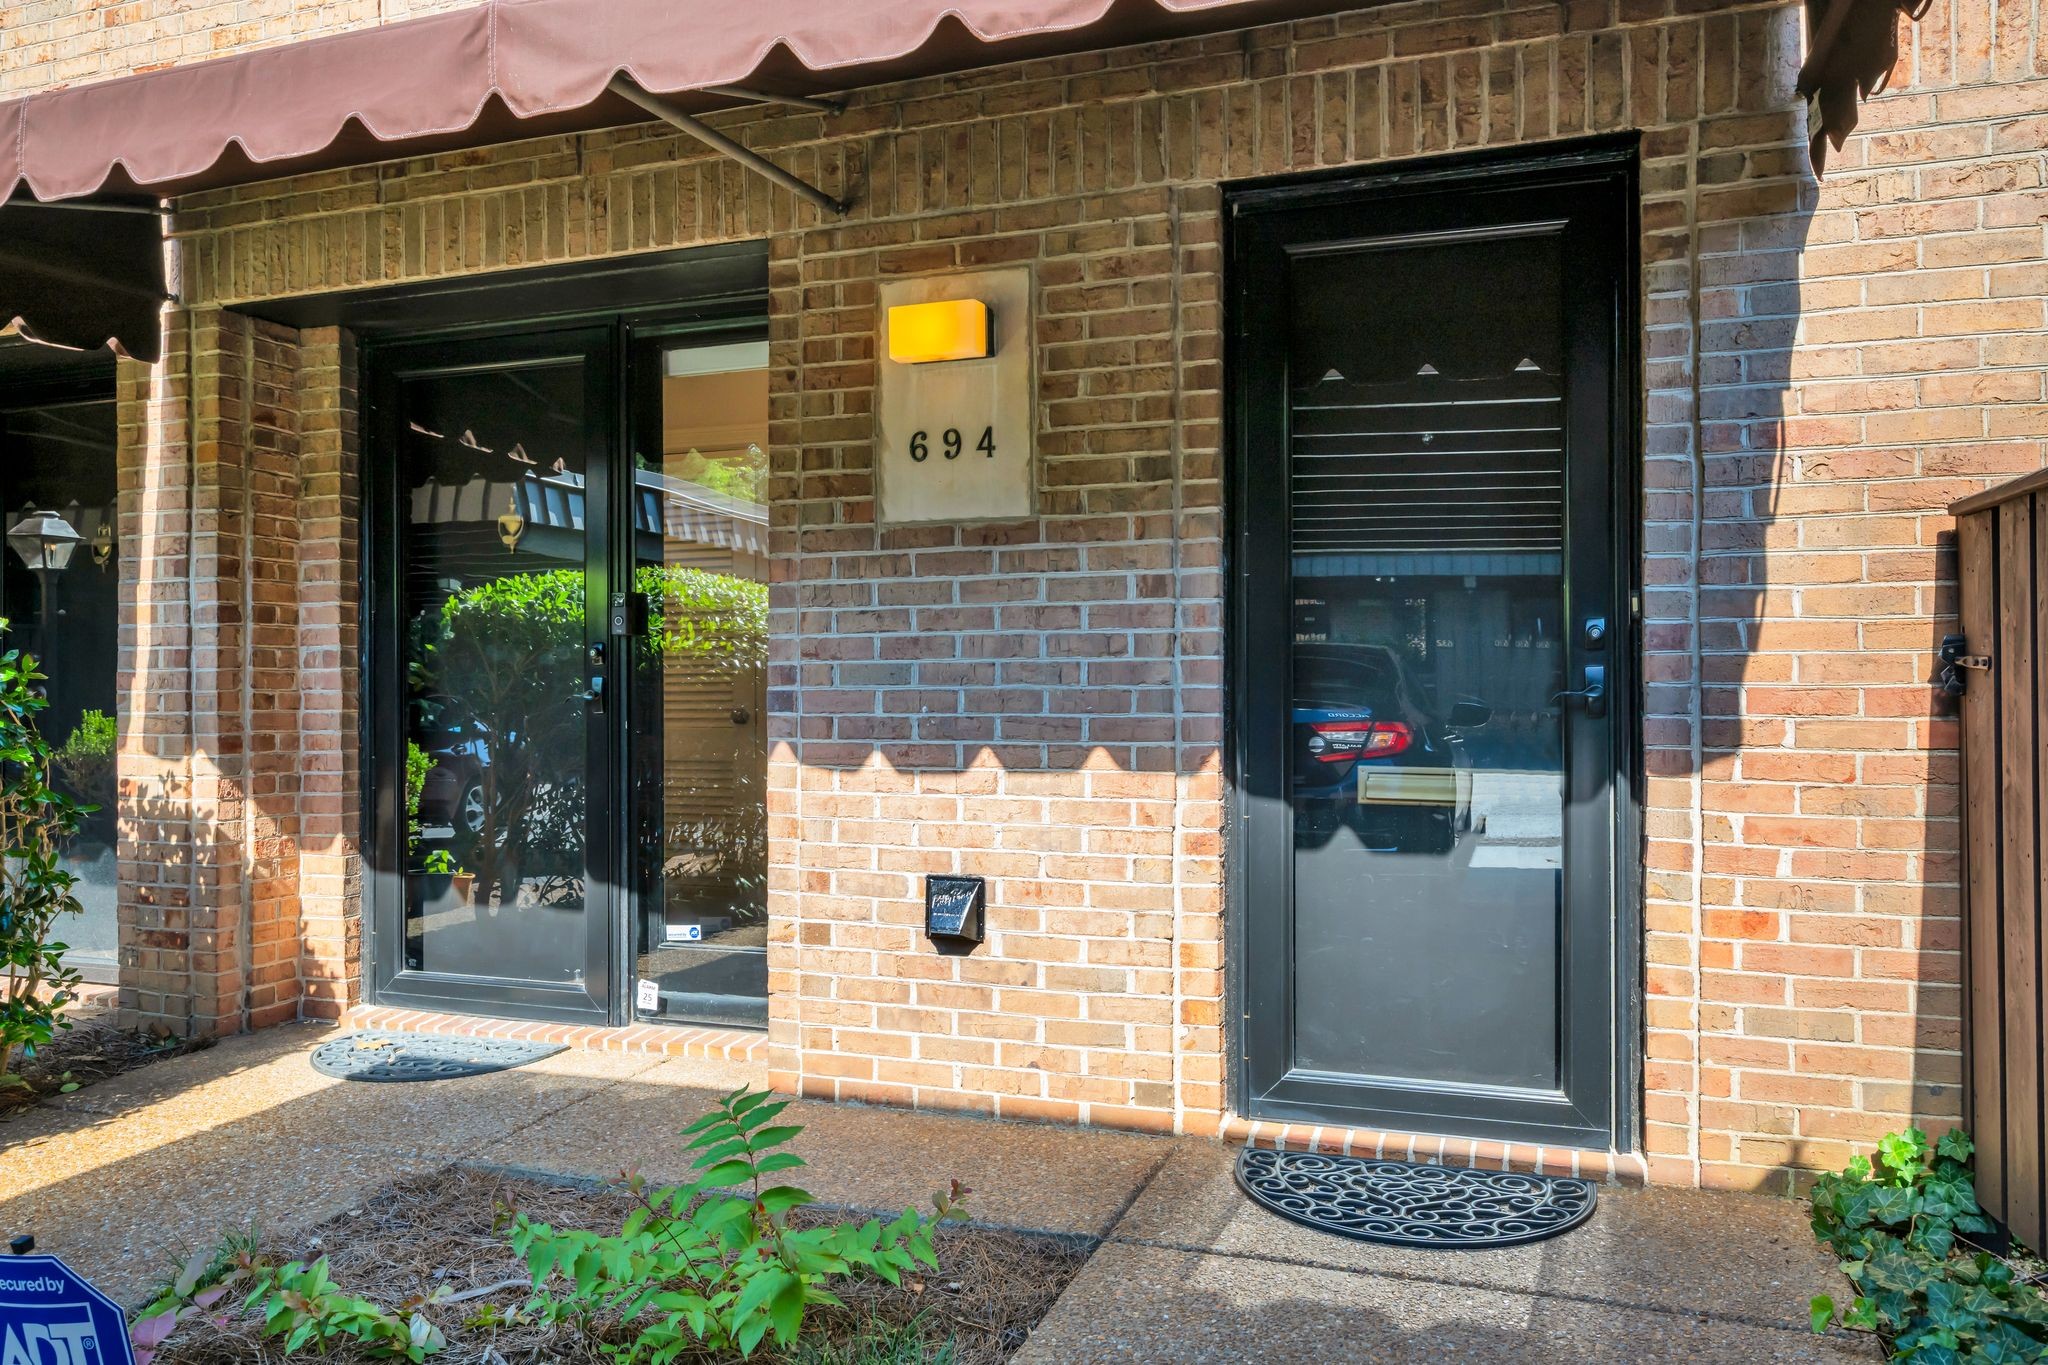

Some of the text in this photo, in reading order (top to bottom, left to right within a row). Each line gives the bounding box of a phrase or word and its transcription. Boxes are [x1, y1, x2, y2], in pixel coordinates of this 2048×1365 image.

[909, 425, 996, 462] 694
[643, 992, 652, 1002] 25
[0, 1276, 65, 1294] ecured by
[2, 1322, 94, 1365] ADT
